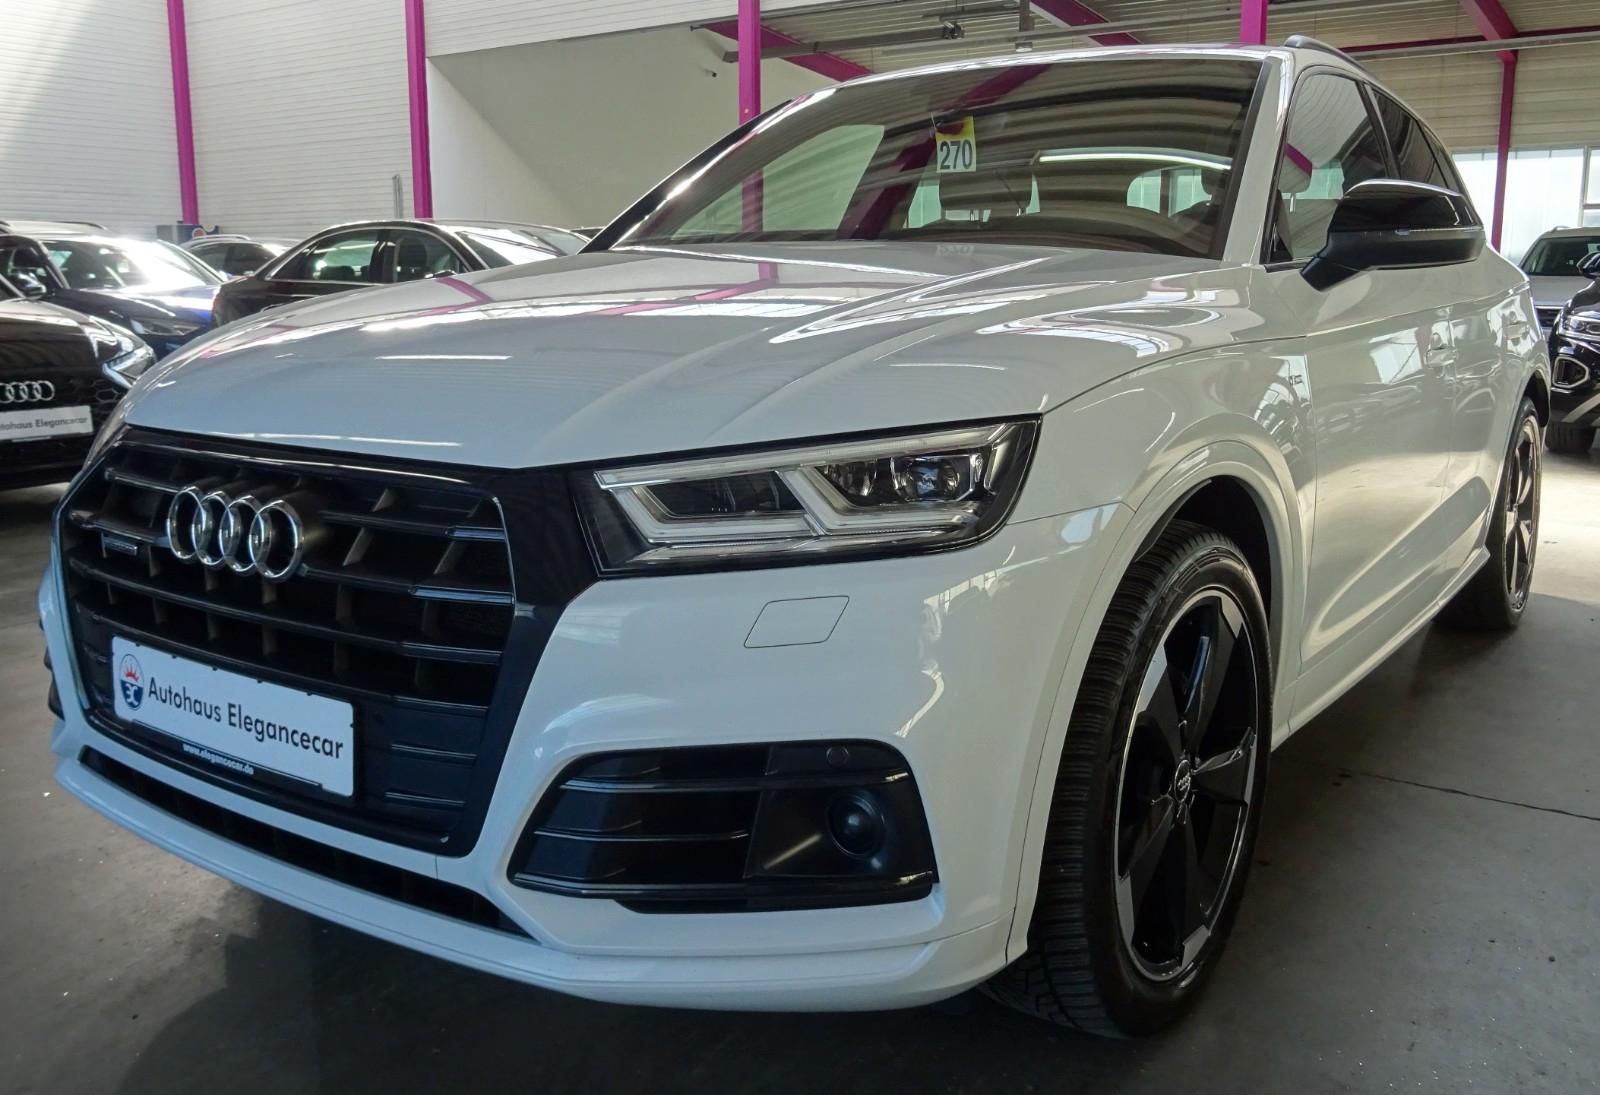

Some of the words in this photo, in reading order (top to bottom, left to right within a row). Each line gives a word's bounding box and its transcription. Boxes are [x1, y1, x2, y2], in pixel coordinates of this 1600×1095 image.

[940, 139, 973, 170] 270
[148, 677, 222, 722] Autohaus
[228, 703, 344, 759] Elegancecar
